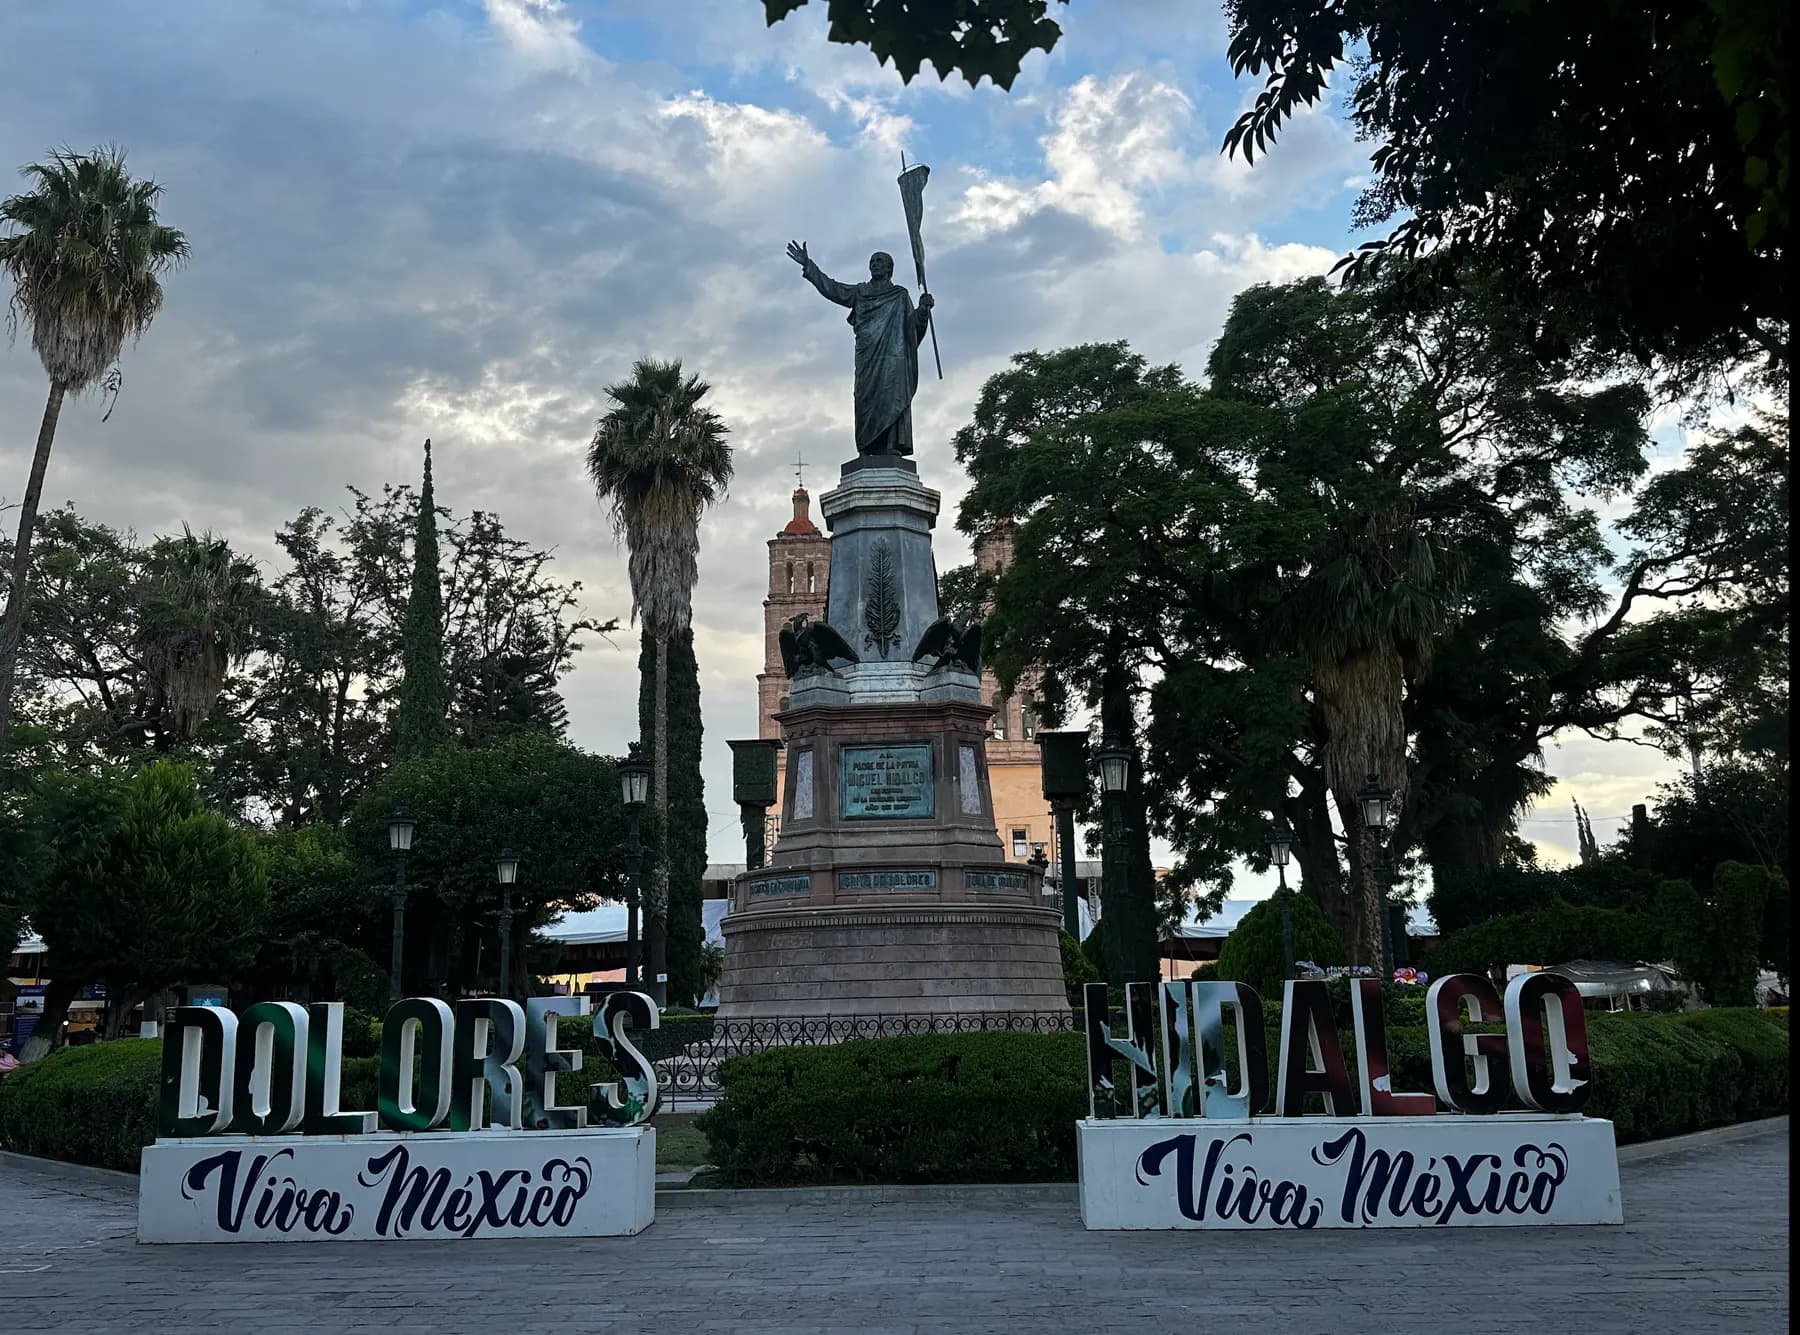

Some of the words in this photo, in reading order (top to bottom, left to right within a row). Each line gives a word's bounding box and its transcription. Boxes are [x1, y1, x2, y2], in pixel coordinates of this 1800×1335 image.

[848, 773, 883, 786] MIGUEL
[886, 771, 926, 786] HIDALGO
[886, 873, 931, 887] DOLORES
[156, 991, 660, 1137] DOLORES
[1084, 973, 1593, 1120] HIDALGO
[181, 1148, 354, 1234] Viva
[1135, 1132, 1323, 1229] Viva
